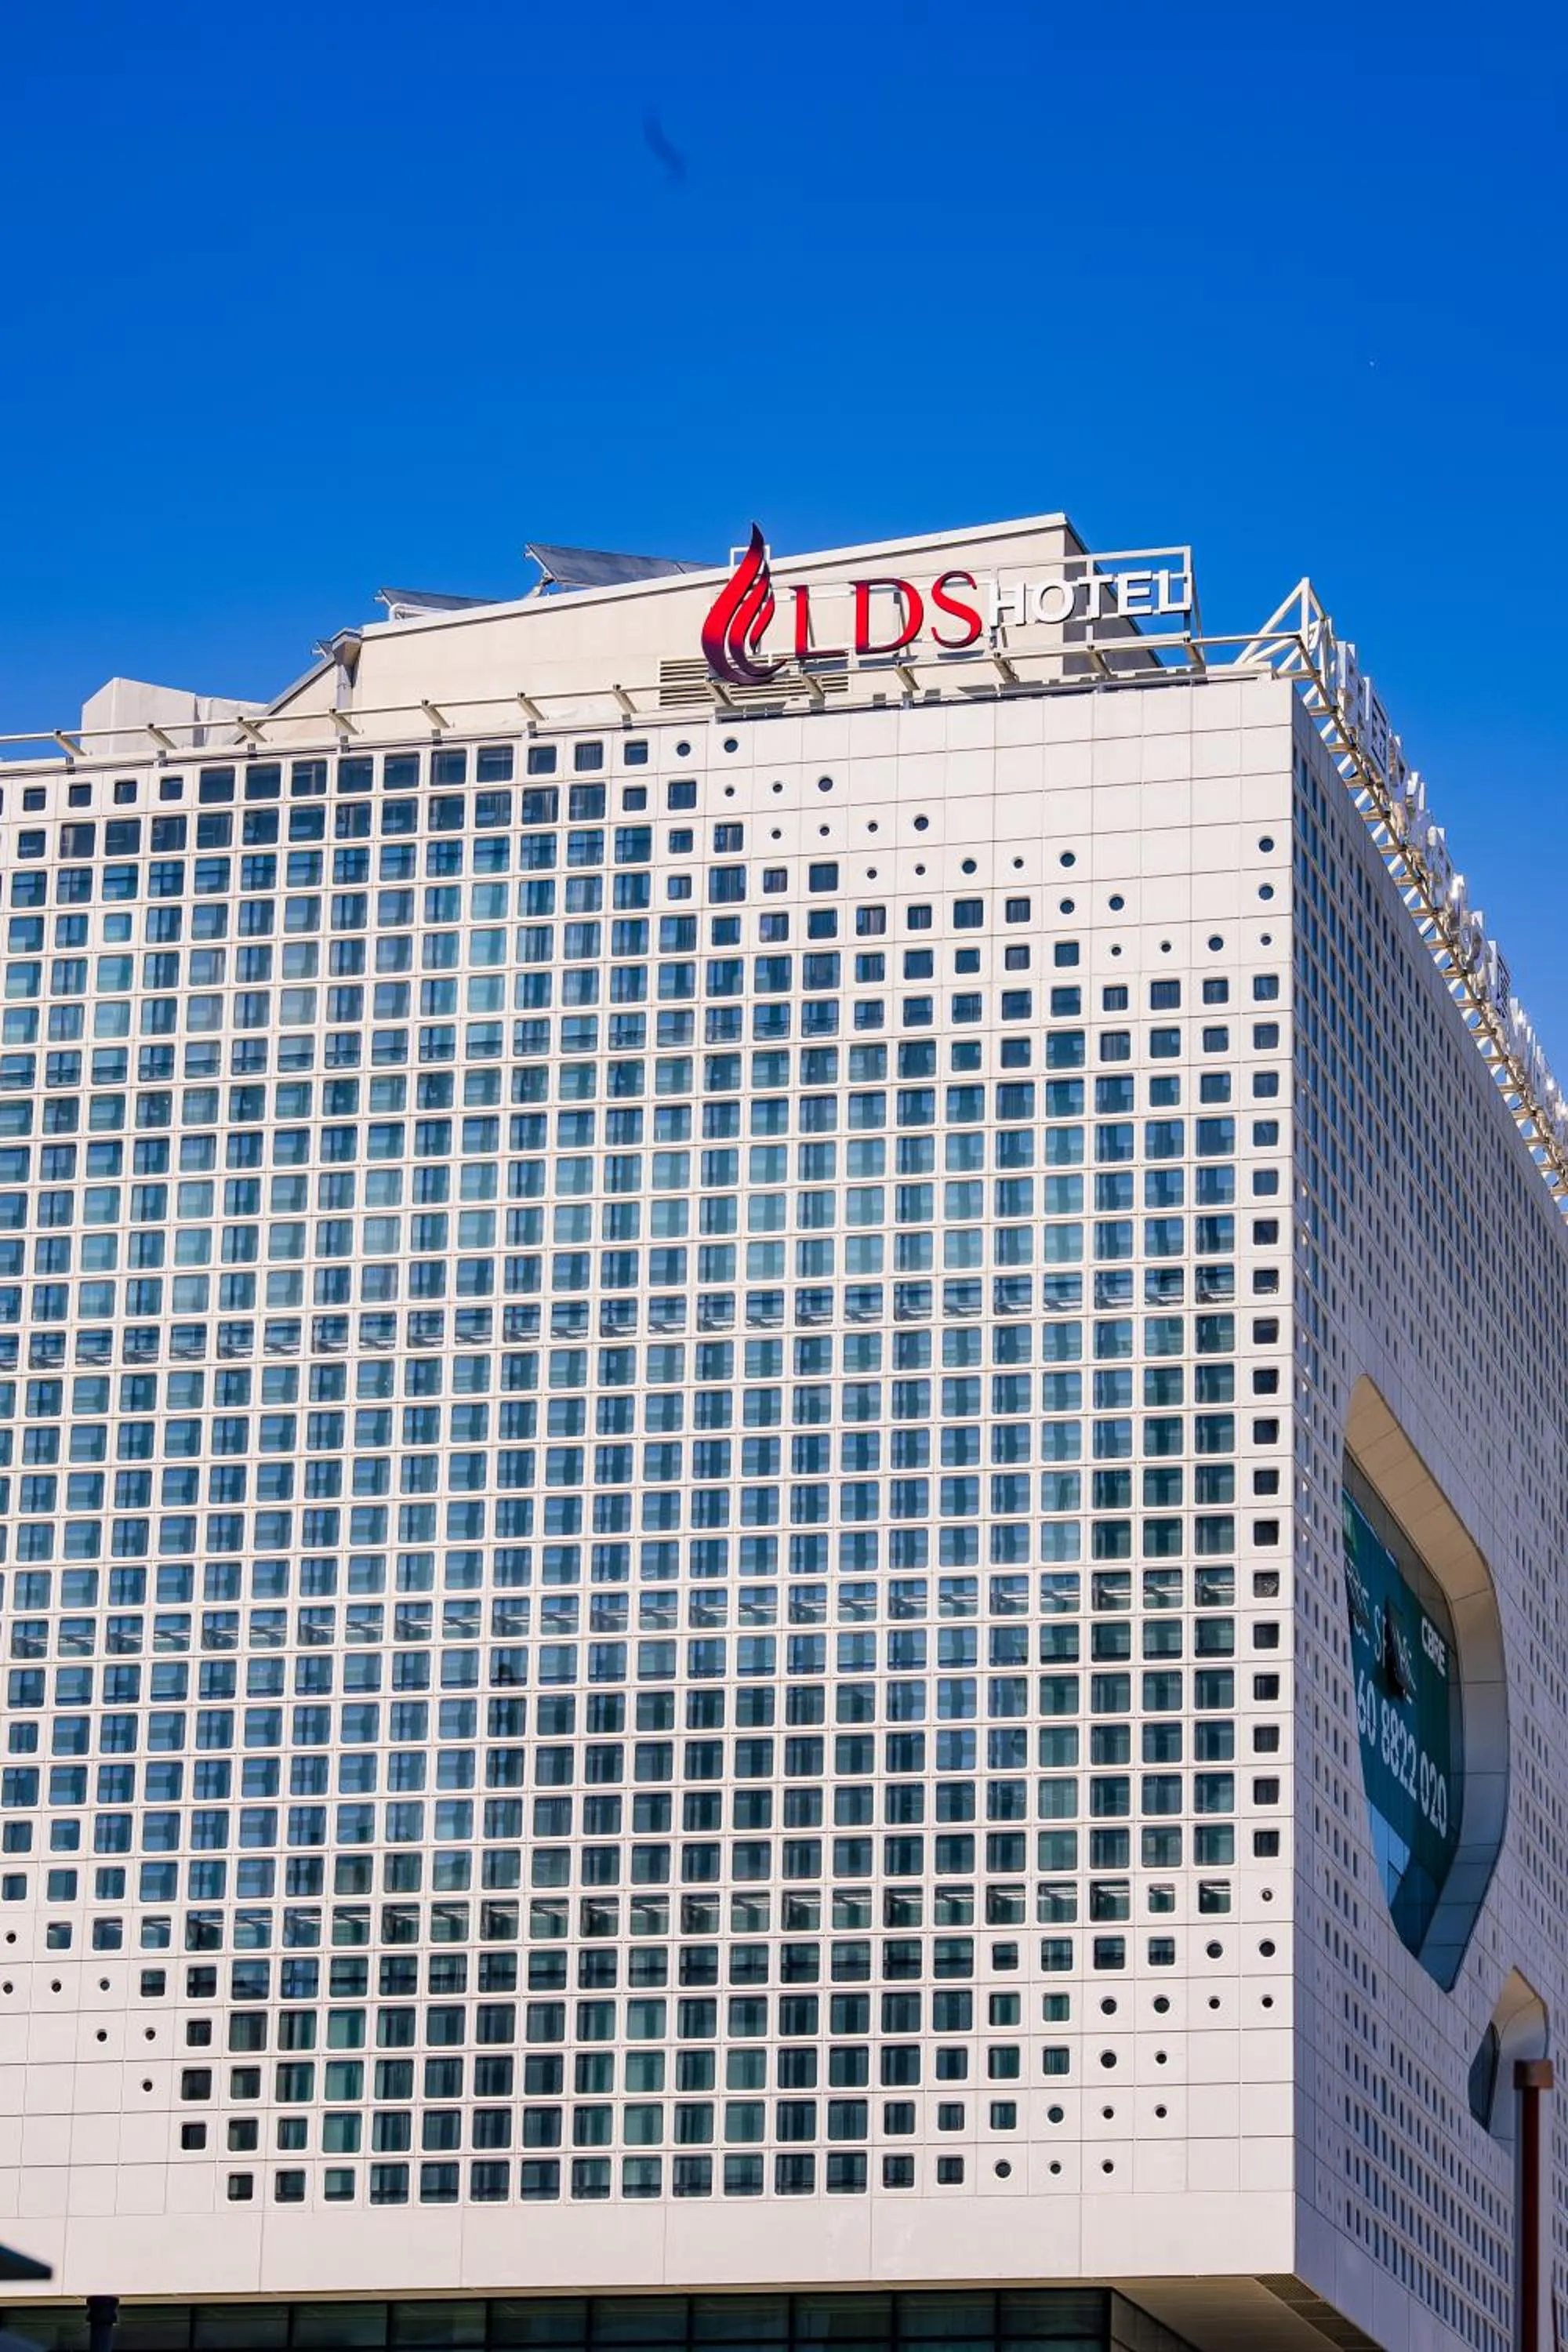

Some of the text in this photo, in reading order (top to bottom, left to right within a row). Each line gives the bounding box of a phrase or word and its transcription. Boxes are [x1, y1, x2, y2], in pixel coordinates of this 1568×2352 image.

[789, 569, 1191, 659] LDS HOTEL
[1421, 1615, 1446, 1677] CBRE
[1381, 1698, 1417, 1802] 8822
[1420, 1751, 1447, 1838] 020
